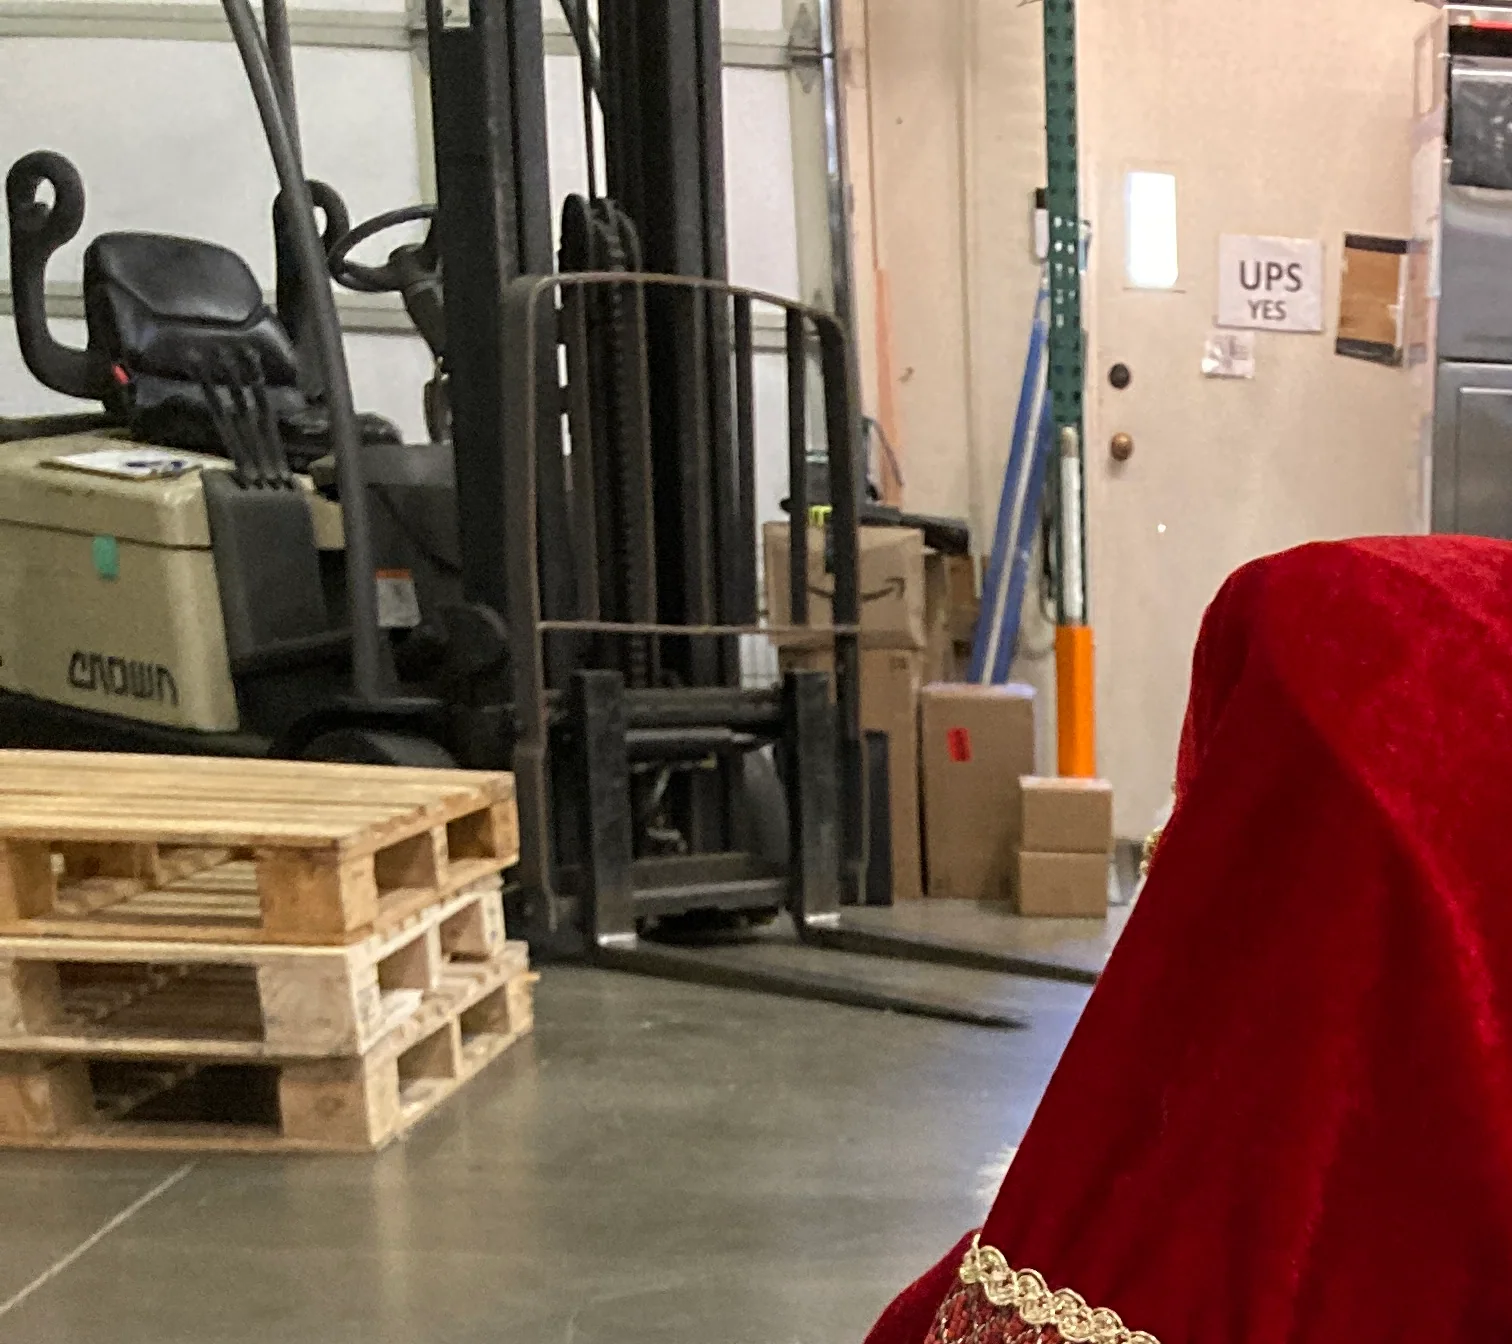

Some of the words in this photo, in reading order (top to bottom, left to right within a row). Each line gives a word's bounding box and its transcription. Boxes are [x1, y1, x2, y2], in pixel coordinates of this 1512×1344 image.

[1239, 260, 1303, 293] UPS
[1248, 299, 1287, 321] YES
[67, 651, 180, 706] CROWN
